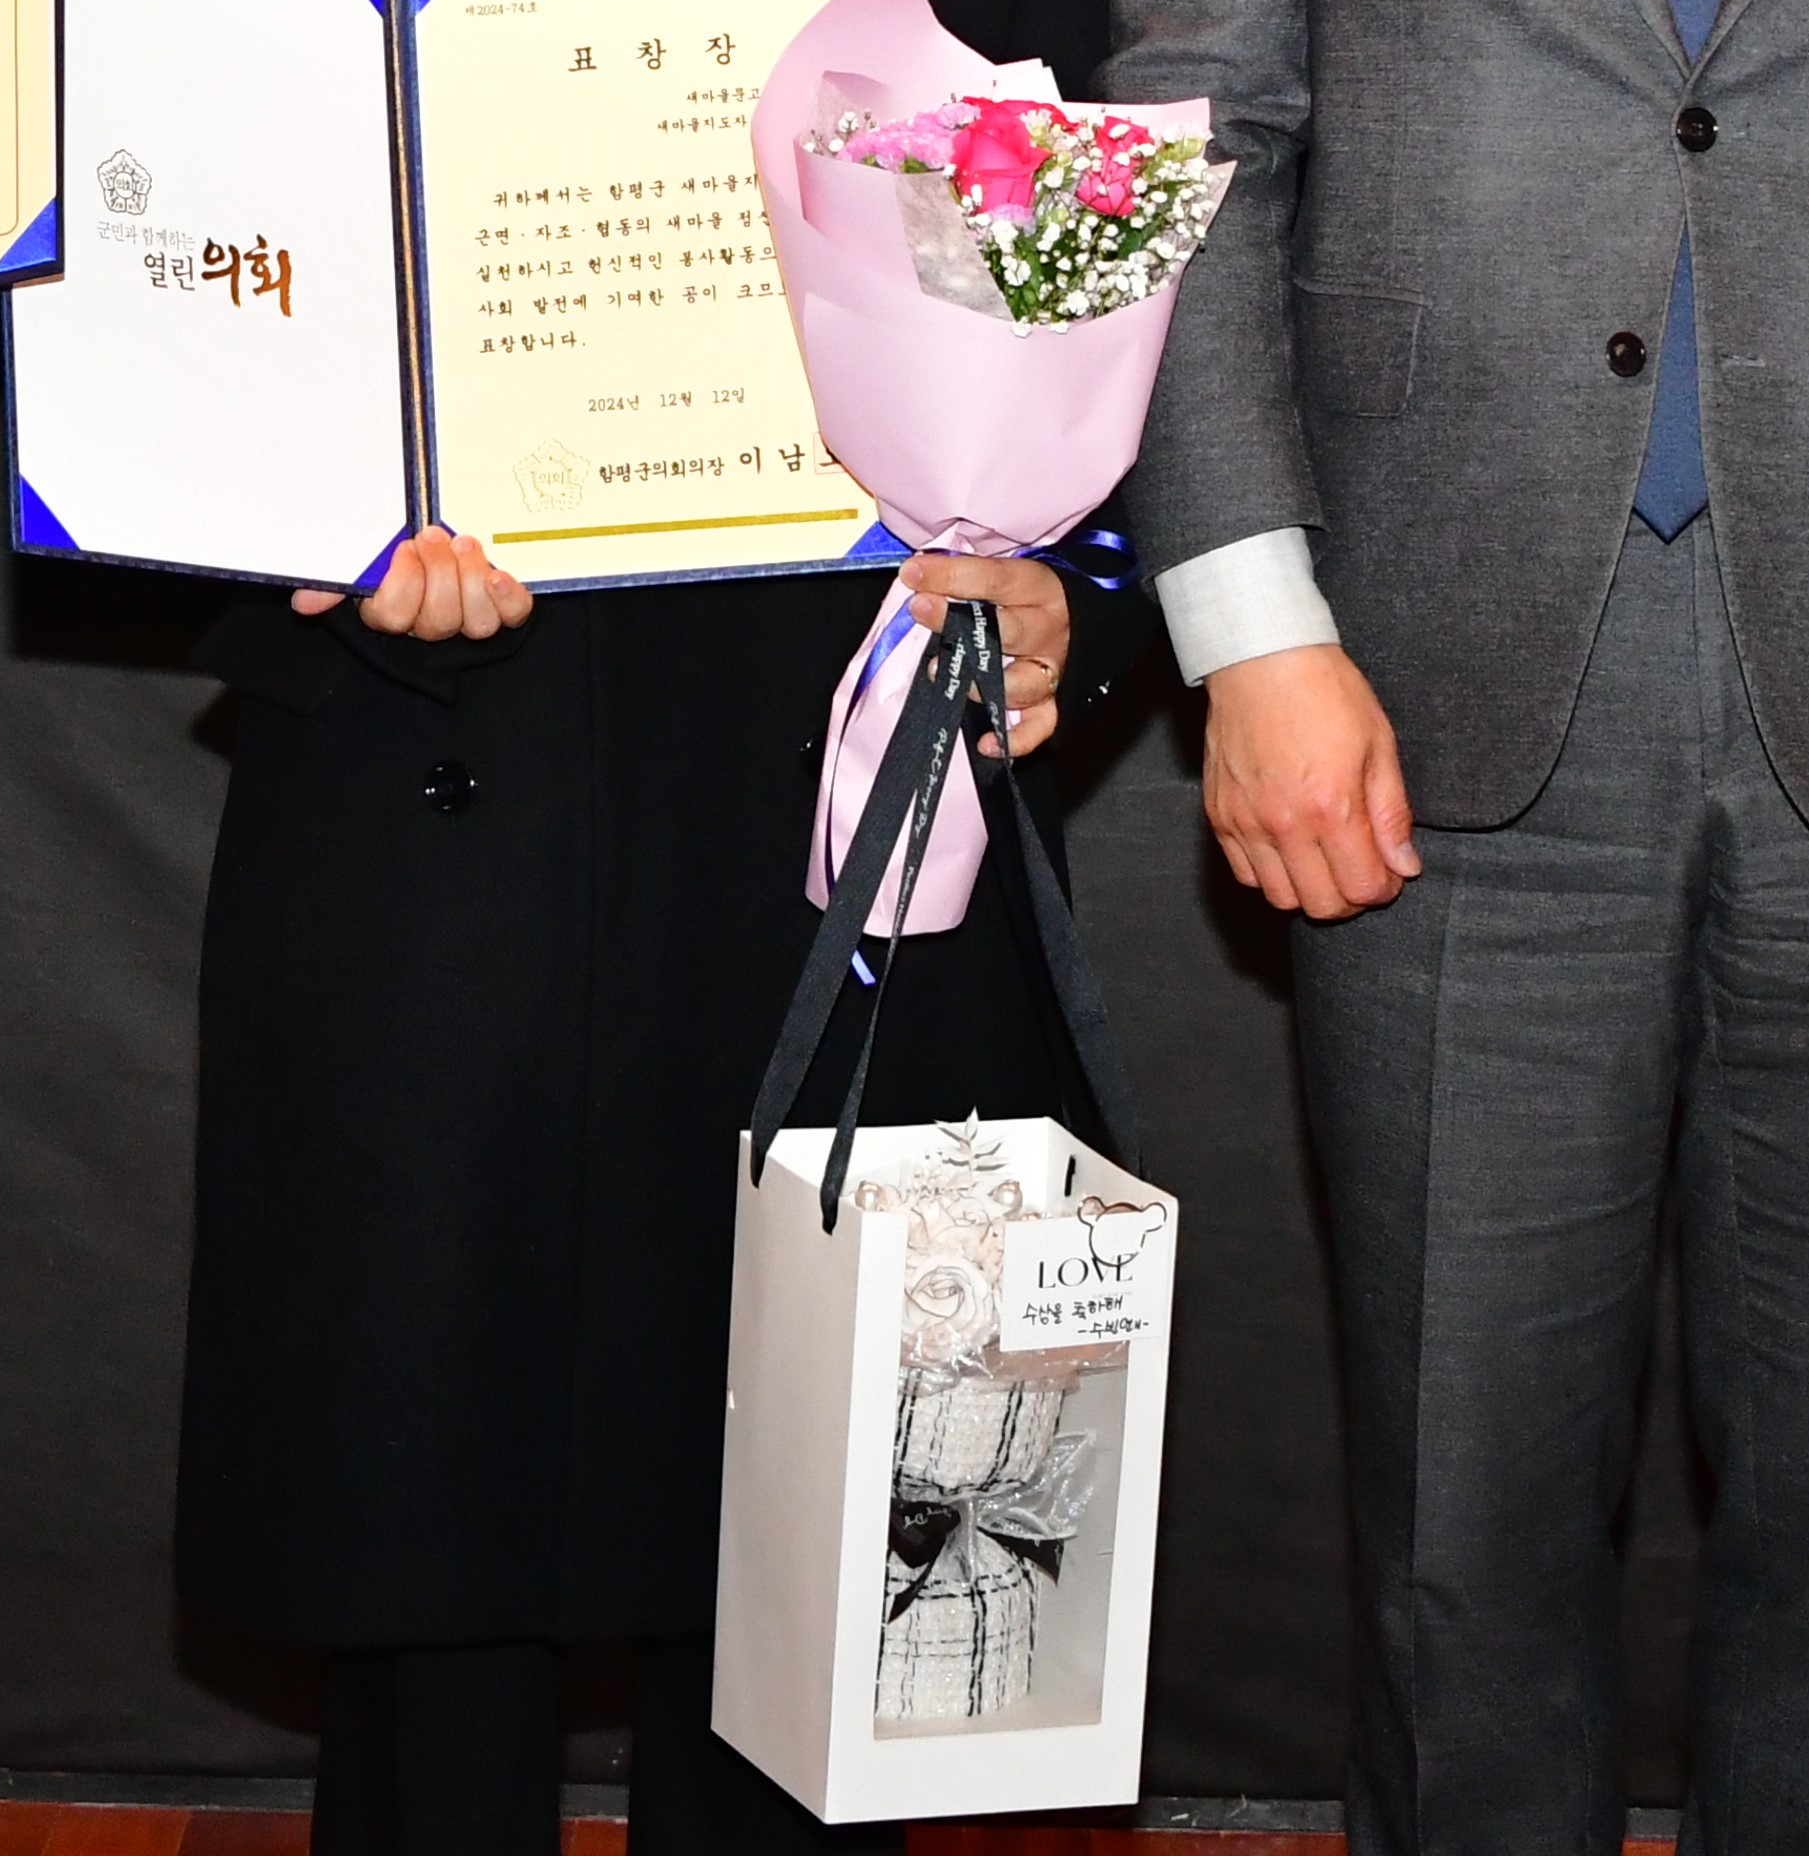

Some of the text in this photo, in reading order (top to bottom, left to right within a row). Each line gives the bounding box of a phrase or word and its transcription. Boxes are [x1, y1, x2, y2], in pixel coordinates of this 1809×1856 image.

[567, 32, 736, 72] 표 창 장
[657, 114, 747, 133] 새마을지도자
[609, 179, 665, 200] 함평군
[97, 221, 196, 251] 군민과 함께하는
[474, 226, 508, 246] 근면
[536, 224, 571, 241] 자조
[595, 216, 649, 238] 협동의
[666, 211, 722, 231] 새마을
[143, 233, 292, 317] 열린 의회
[476, 260, 573, 283] 실천하시고
[588, 251, 662, 275] 헌신적인
[478, 299, 512, 316] 사회
[532, 293, 586, 315] 발전에
[607, 287, 664, 308] 기여한
[681, 283, 716, 303] 공이
[479, 330, 585, 353] 표창합니다.
[588, 387, 744, 412] 2024년 12월 12일
[598, 456, 725, 483] 함평군의회의장
[738, 445, 761, 474] 이
[777, 442, 806, 472] 남
[977, 650, 991, 672] Day
[944, 677, 960, 700] Day
[1038, 1253, 1139, 1288] LOVE
[1022, 1302, 1063, 1326] 수상을
